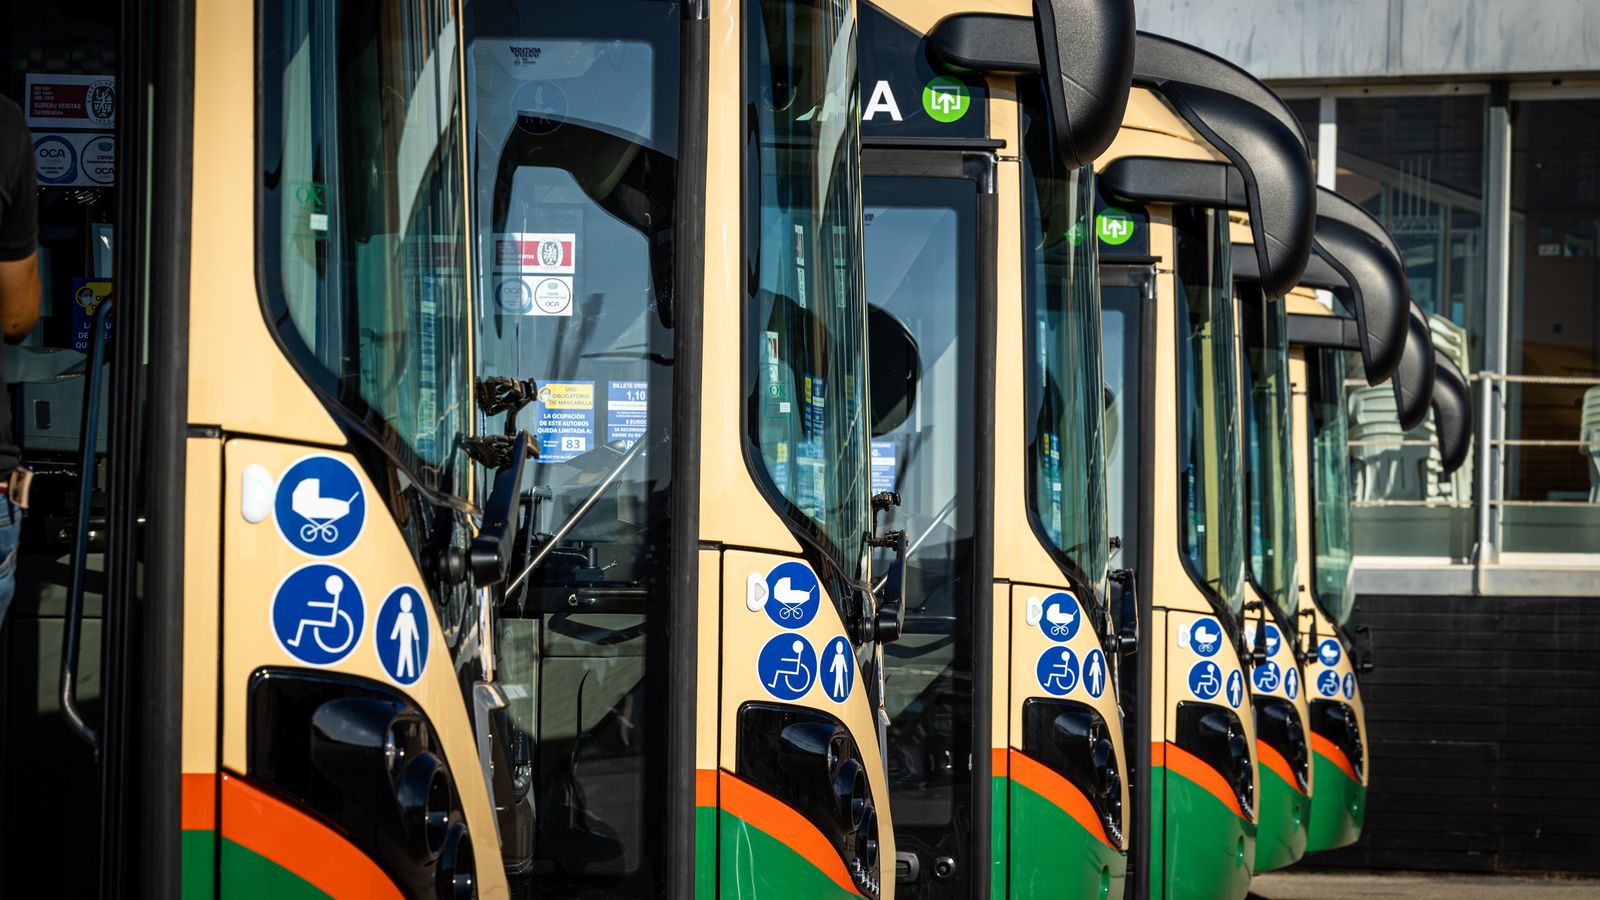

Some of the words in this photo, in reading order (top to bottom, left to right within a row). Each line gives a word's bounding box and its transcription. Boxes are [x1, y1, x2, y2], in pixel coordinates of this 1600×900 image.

[862, 80, 903, 121] A
[39, 148, 66, 158] OCA
[94, 167, 115, 175] OCA
[296, 186, 323, 206] OK
[566, 440, 580, 449] 83
